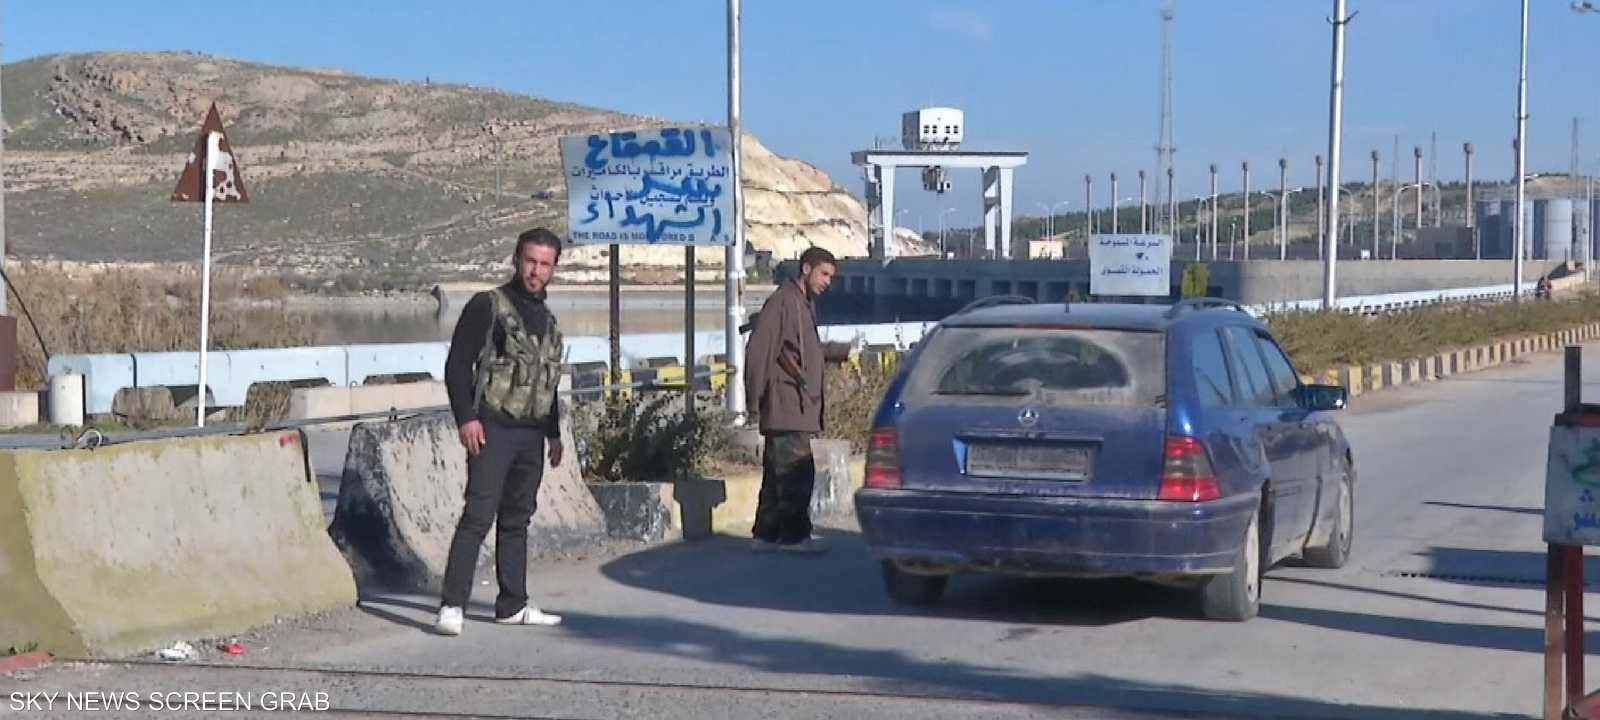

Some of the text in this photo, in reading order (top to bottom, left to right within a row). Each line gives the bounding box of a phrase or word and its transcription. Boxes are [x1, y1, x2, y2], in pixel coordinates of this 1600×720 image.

[572, 232, 590, 240] THE
[592, 232, 617, 240] ROAD
[620, 232, 629, 240] IS
[632, 232, 686, 241] MOORED
